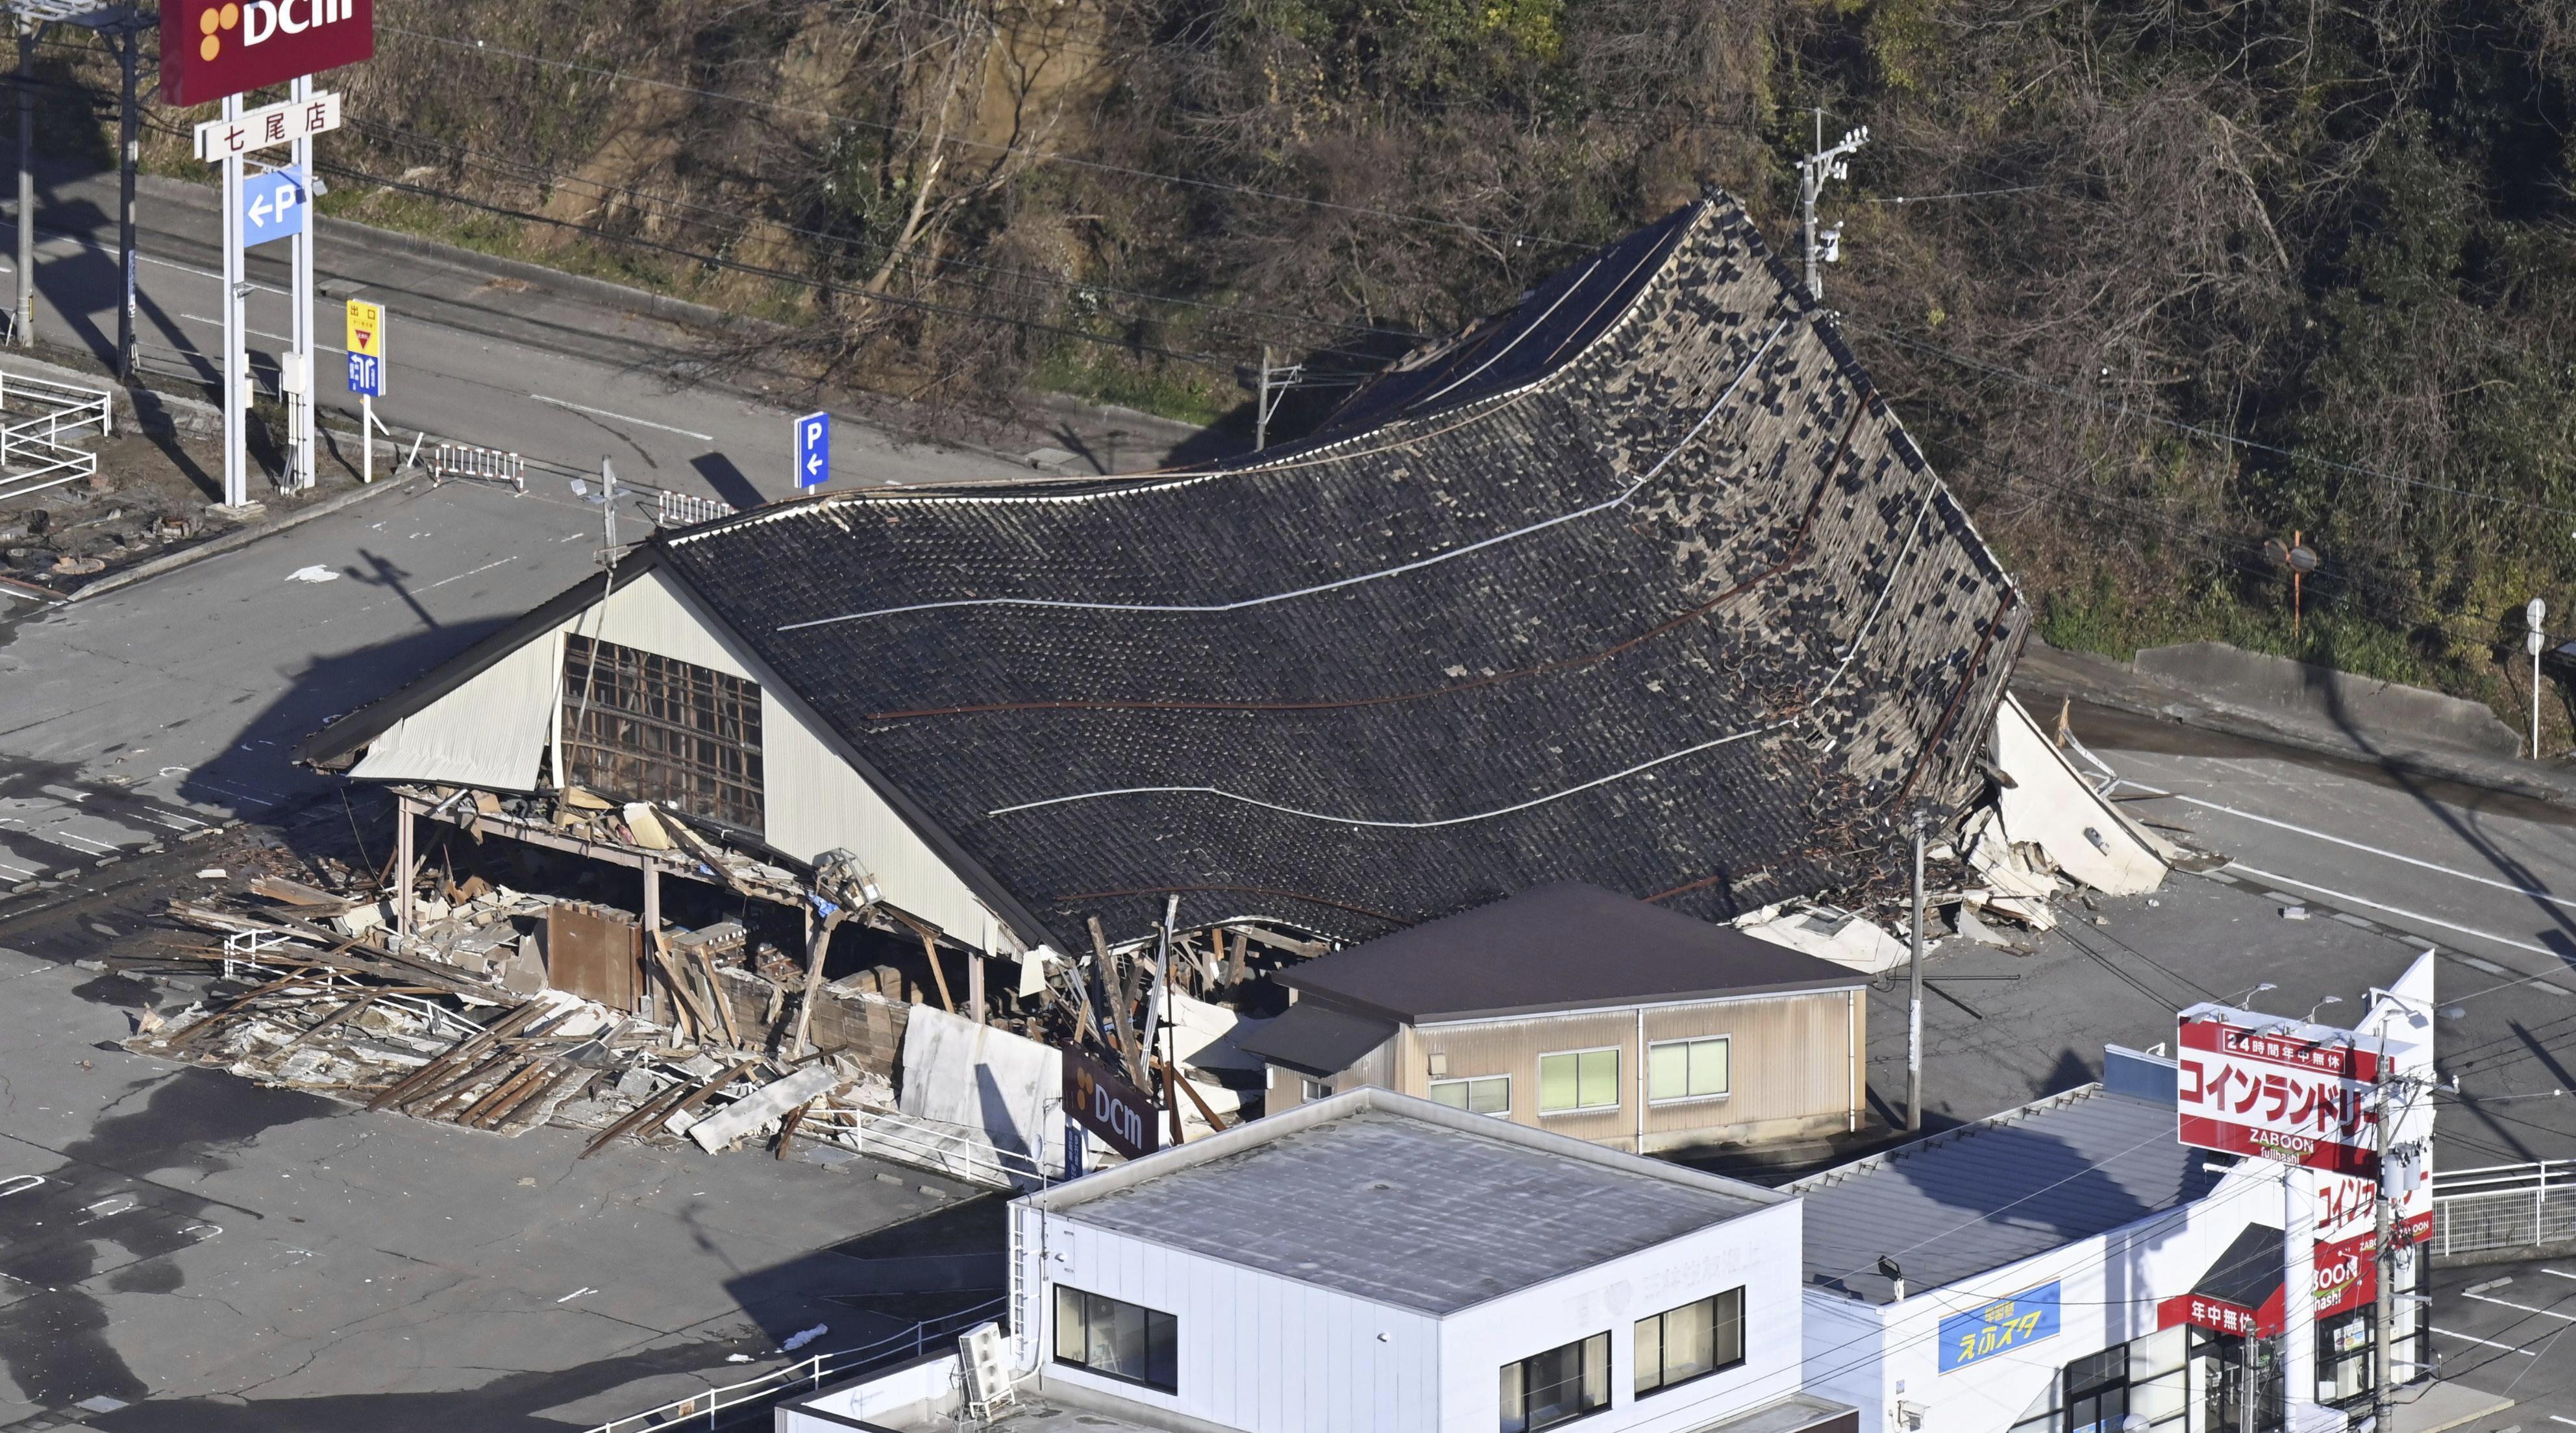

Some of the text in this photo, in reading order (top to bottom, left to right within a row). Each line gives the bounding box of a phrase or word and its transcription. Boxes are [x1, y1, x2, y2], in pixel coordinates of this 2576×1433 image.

[224, 102, 326, 152] 七尾店
[276, 184, 297, 223] P
[351, 305, 375, 321] 出口
[808, 422, 822, 450] P
[2227, 1035, 2340, 1068] 24時間年中無休
[2180, 1059, 2378, 1136] コインランドリー
[2250, 1129, 2314, 1153] ZABOON
[2261, 1147, 2299, 1164] fujihashi
[2191, 1300, 2253, 1333] 年中無休
[1957, 1310, 2042, 1363] えふスタ
